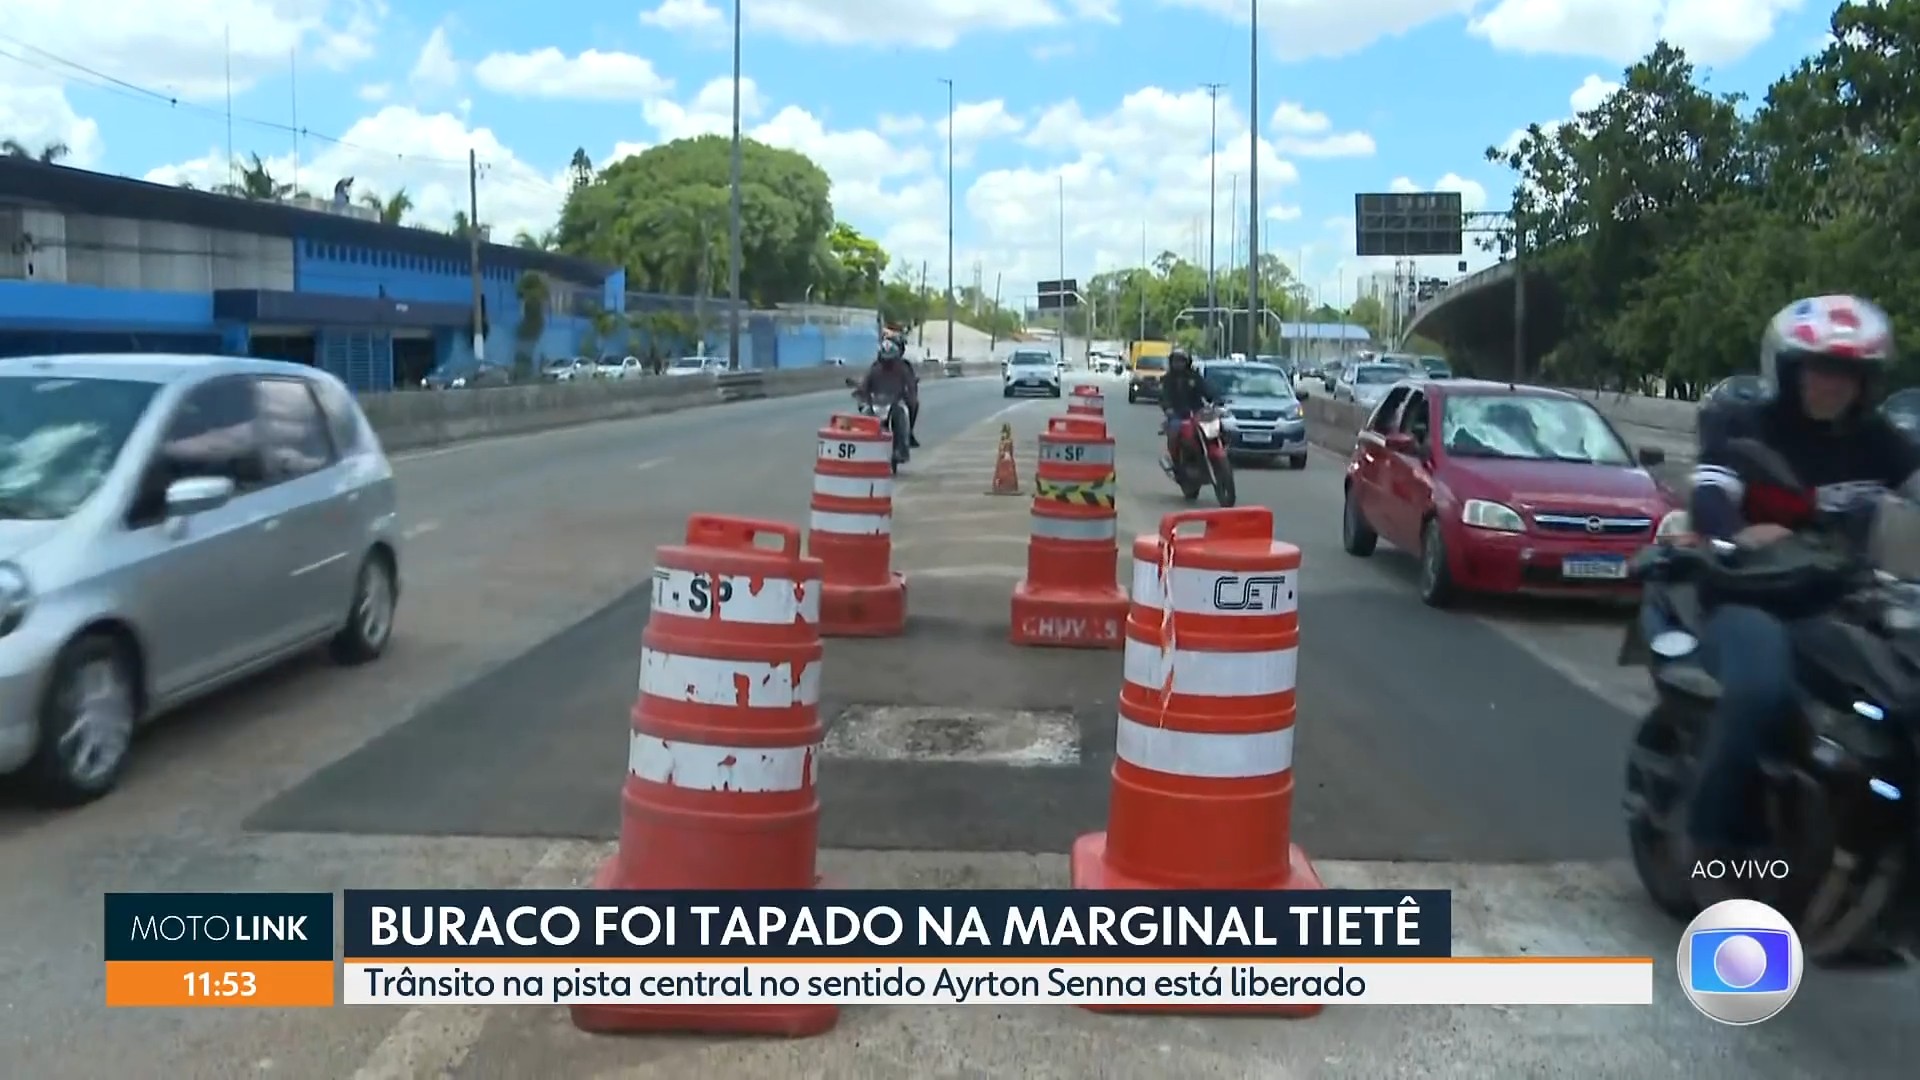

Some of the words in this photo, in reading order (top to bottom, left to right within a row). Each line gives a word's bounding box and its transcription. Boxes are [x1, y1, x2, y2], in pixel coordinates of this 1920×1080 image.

[838, 442, 857, 459] SP
[1064, 446, 1085, 462] SP
[1213, 576, 1286, 611] CET
